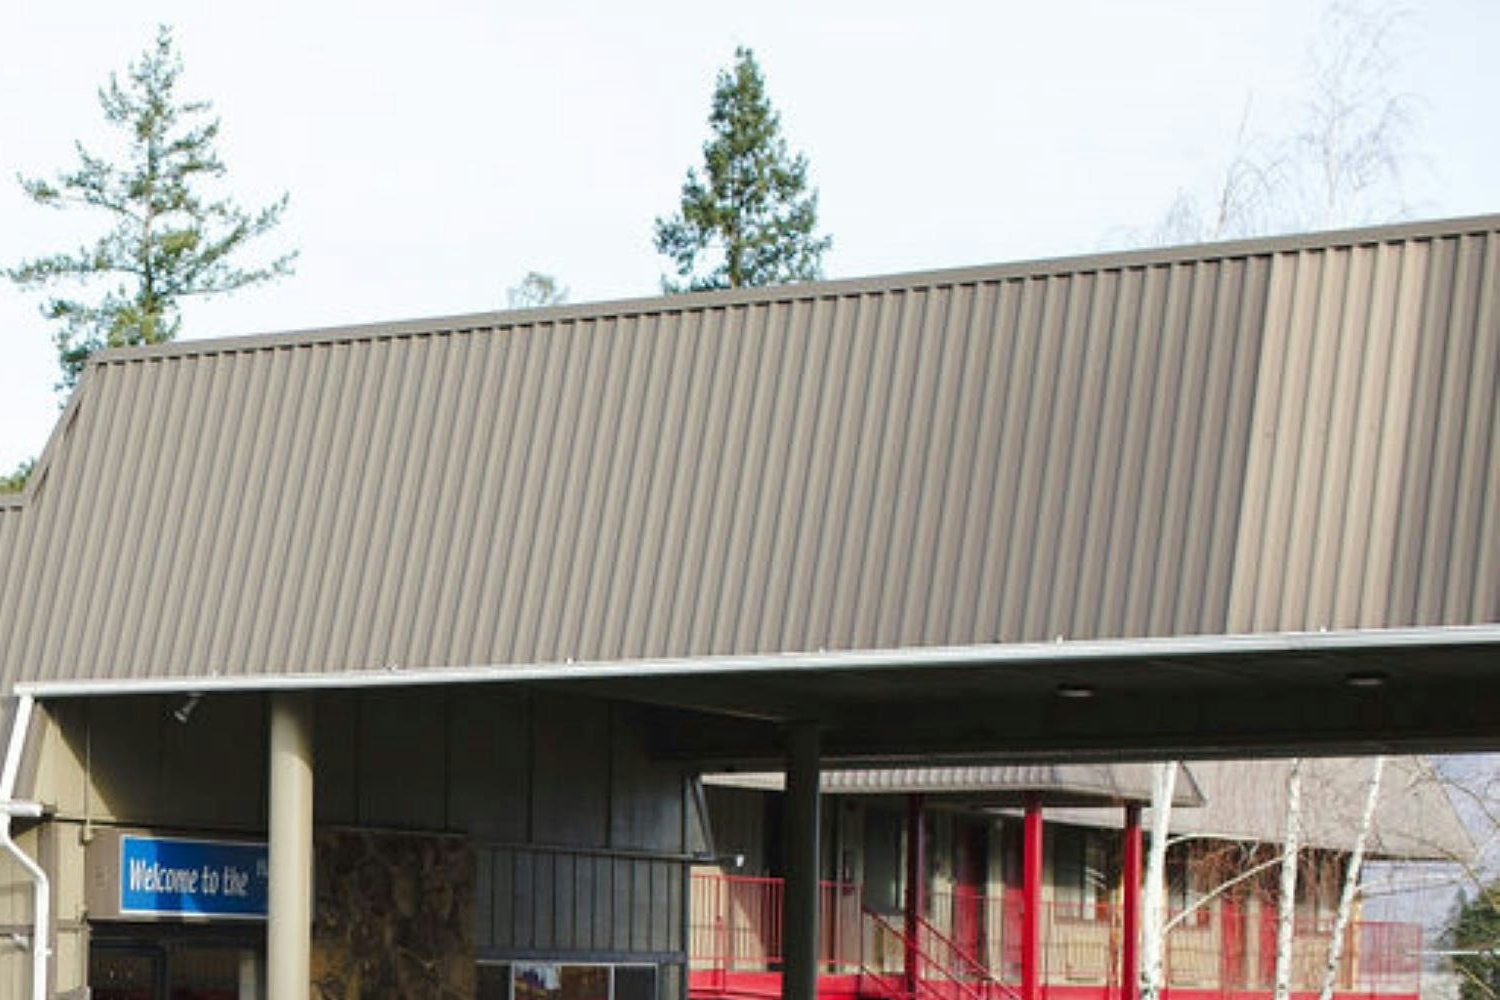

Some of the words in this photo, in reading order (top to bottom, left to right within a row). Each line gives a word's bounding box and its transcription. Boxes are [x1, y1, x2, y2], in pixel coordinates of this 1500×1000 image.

[129, 857, 199, 894] Welcome
[203, 865, 219, 895] to
[222, 866, 249, 897] the
